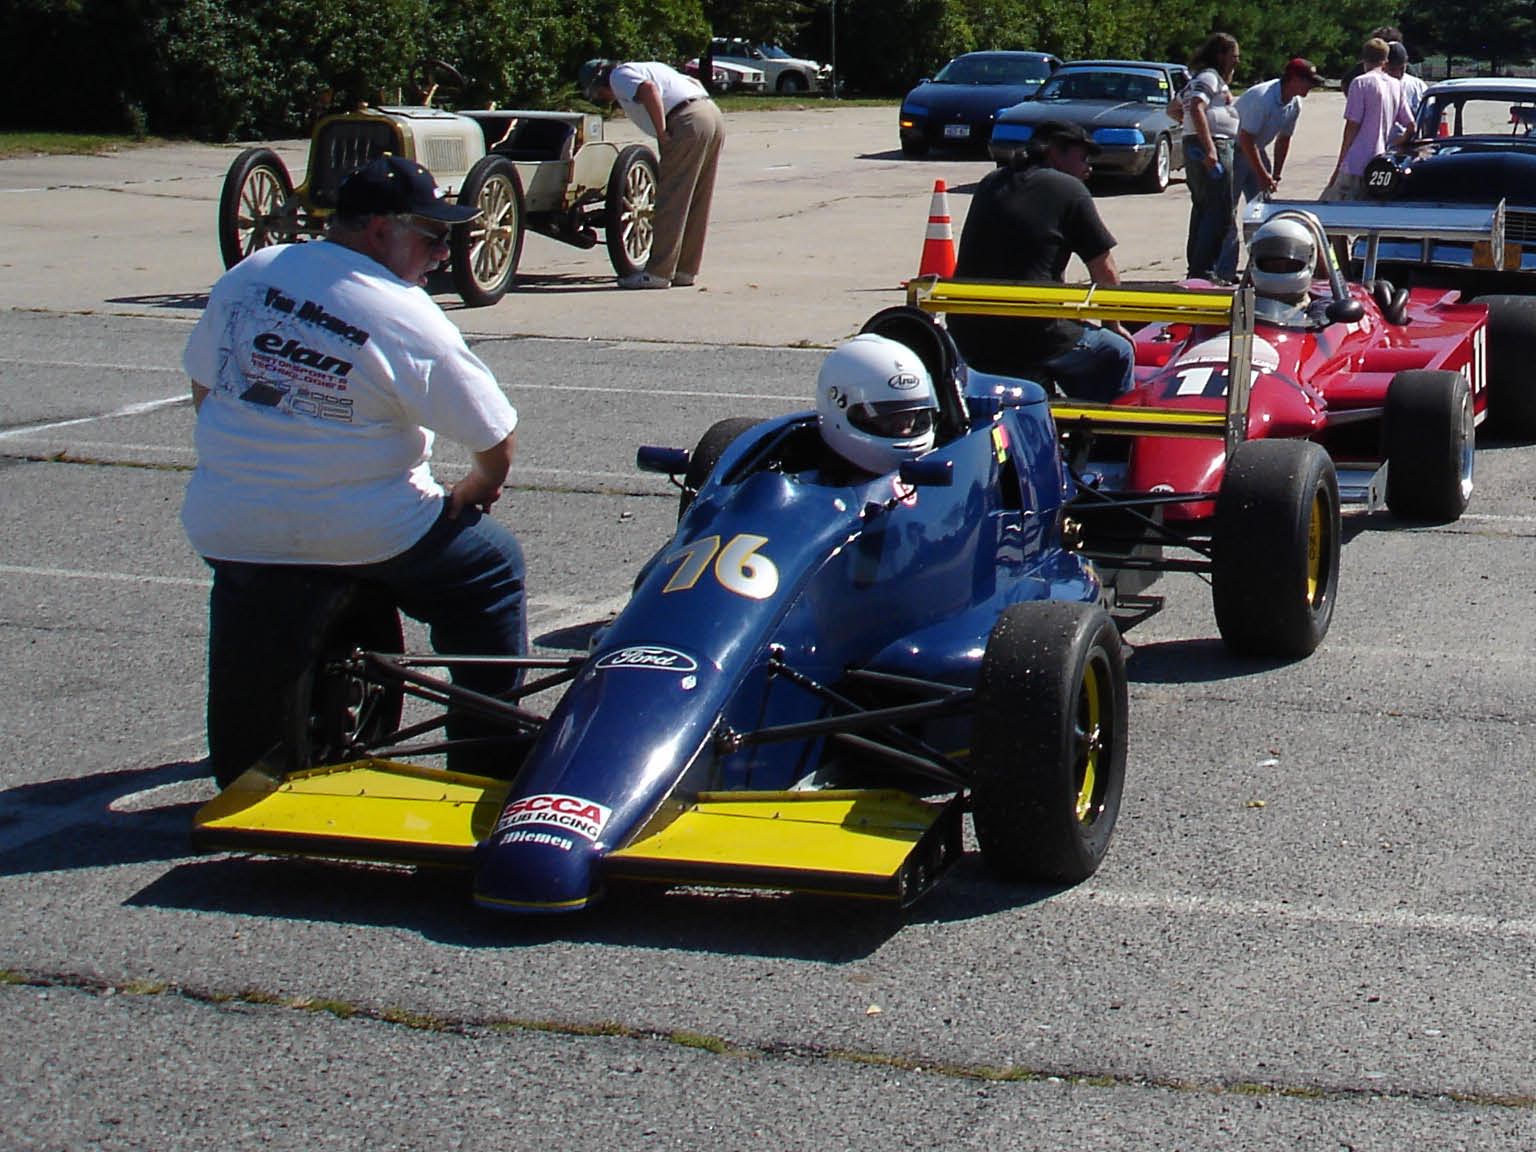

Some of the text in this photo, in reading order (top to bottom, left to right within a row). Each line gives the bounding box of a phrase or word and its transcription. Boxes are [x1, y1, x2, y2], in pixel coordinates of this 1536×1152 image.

[1369, 171, 1392, 186] 250
[253, 333, 354, 377] elan
[611, 649, 678, 667] Ford
[503, 796, 601, 825] SCCA
[534, 812, 599, 838] RACING
